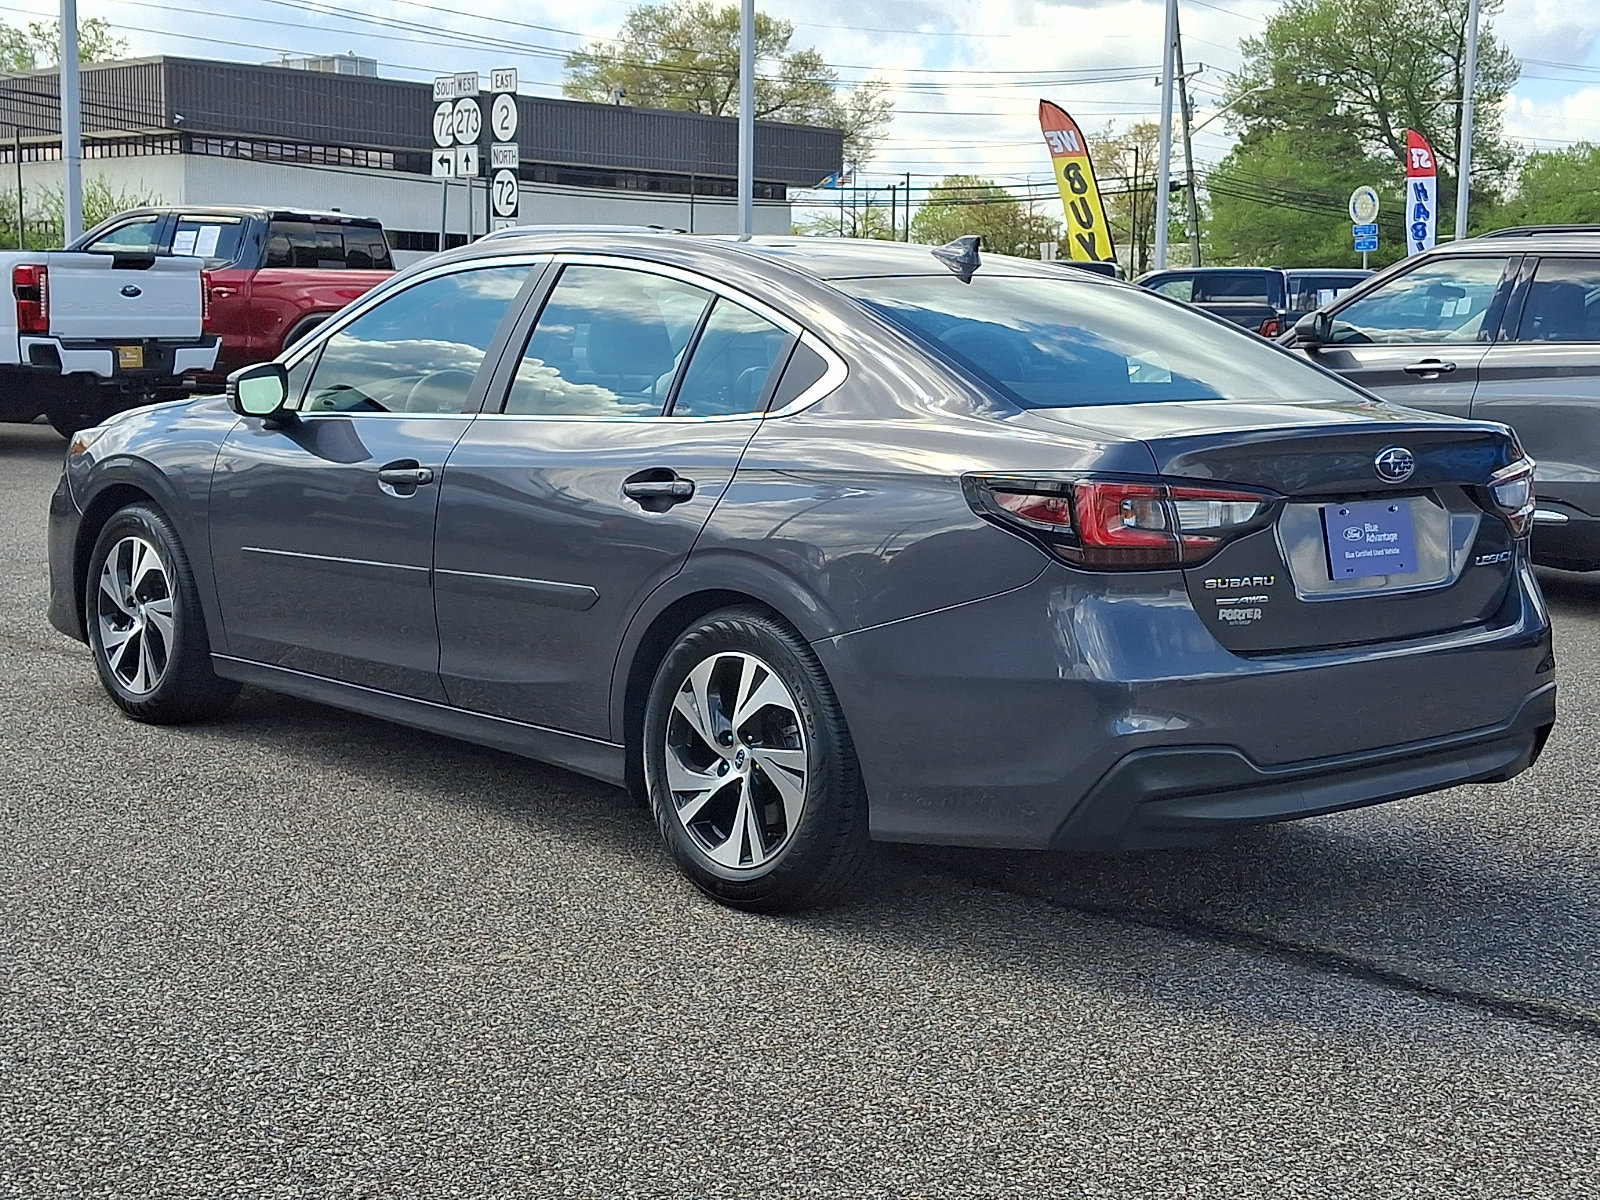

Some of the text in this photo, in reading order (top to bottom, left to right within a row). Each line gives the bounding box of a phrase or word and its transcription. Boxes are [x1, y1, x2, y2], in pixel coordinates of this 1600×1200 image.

[457, 77, 475, 91] WEST
[495, 74, 513, 89] EAST
[435, 82, 454, 96] SOUT
[437, 112, 453, 137] 72
[456, 108, 479, 134] 273
[500, 104, 510, 131] 2
[493, 148, 517, 165] NORTH
[496, 180, 515, 206] 72
[1364, 523, 1379, 533] Blue
[1366, 532, 1398, 543] Advantage
[1204, 575, 1275, 589] SUBARU
[1218, 608, 1262, 620] PORTER
